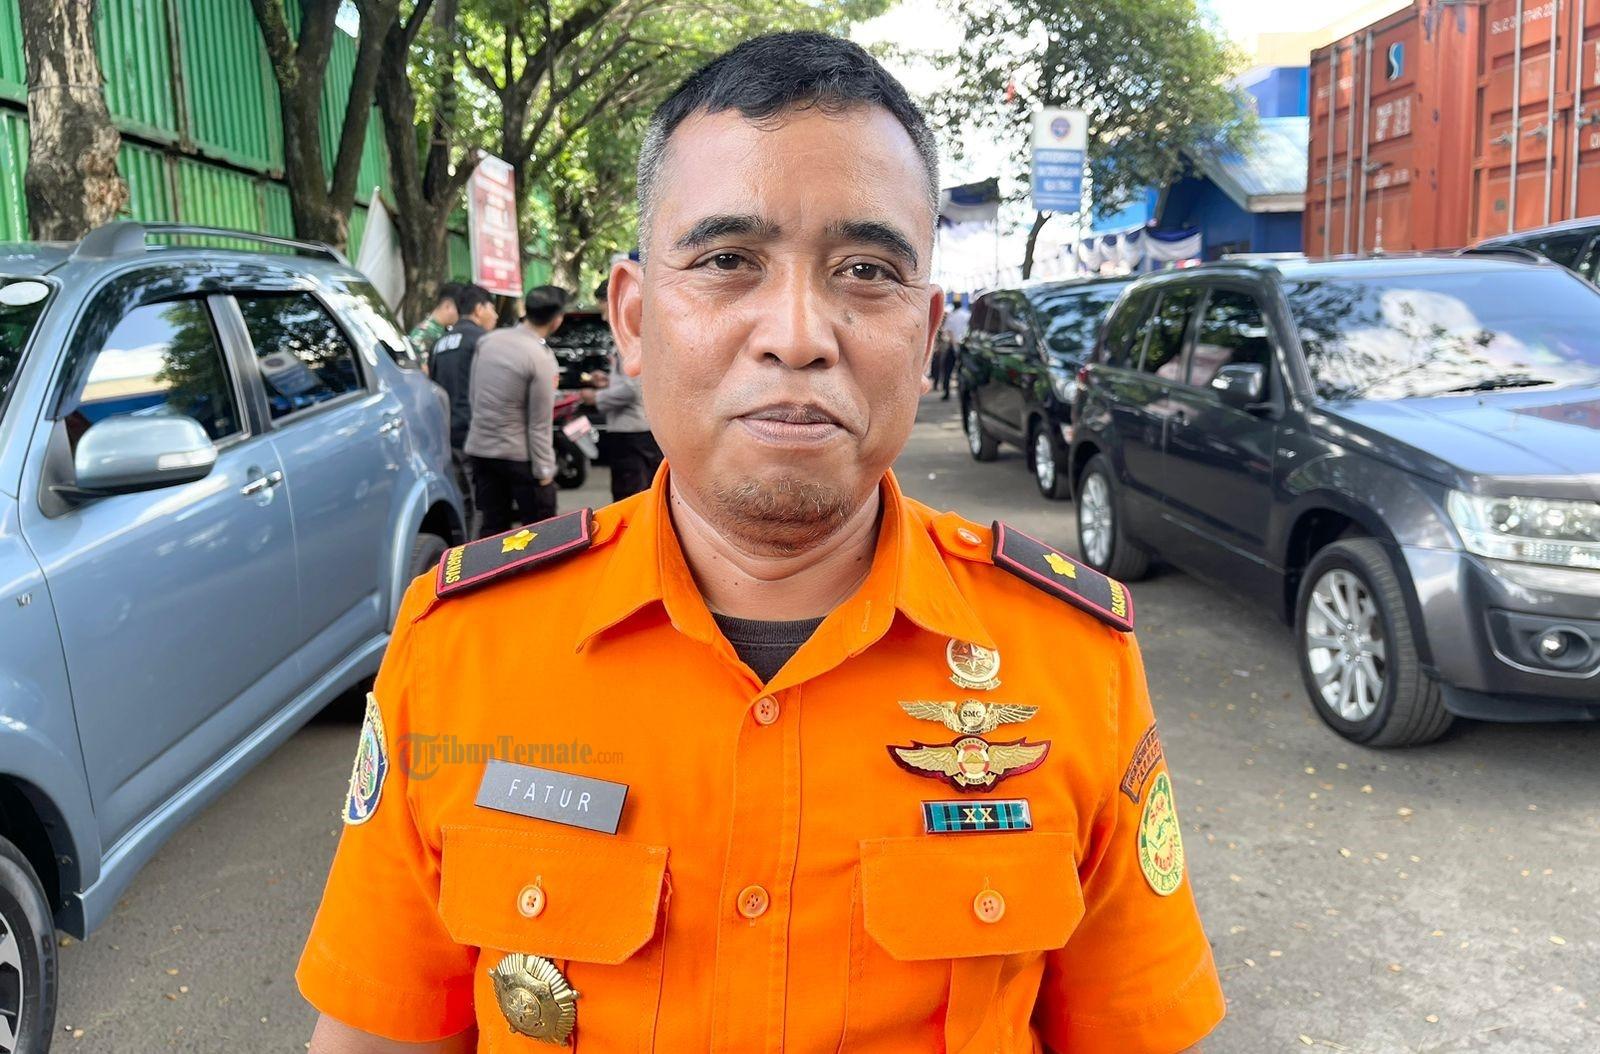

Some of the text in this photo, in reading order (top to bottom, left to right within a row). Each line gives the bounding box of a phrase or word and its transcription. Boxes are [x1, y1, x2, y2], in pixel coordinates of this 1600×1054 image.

[1106, 577, 1126, 617] BASAR
[962, 710, 982, 718] SMC
[508, 778, 592, 812] FATUR
[962, 806, 995, 823] XX
